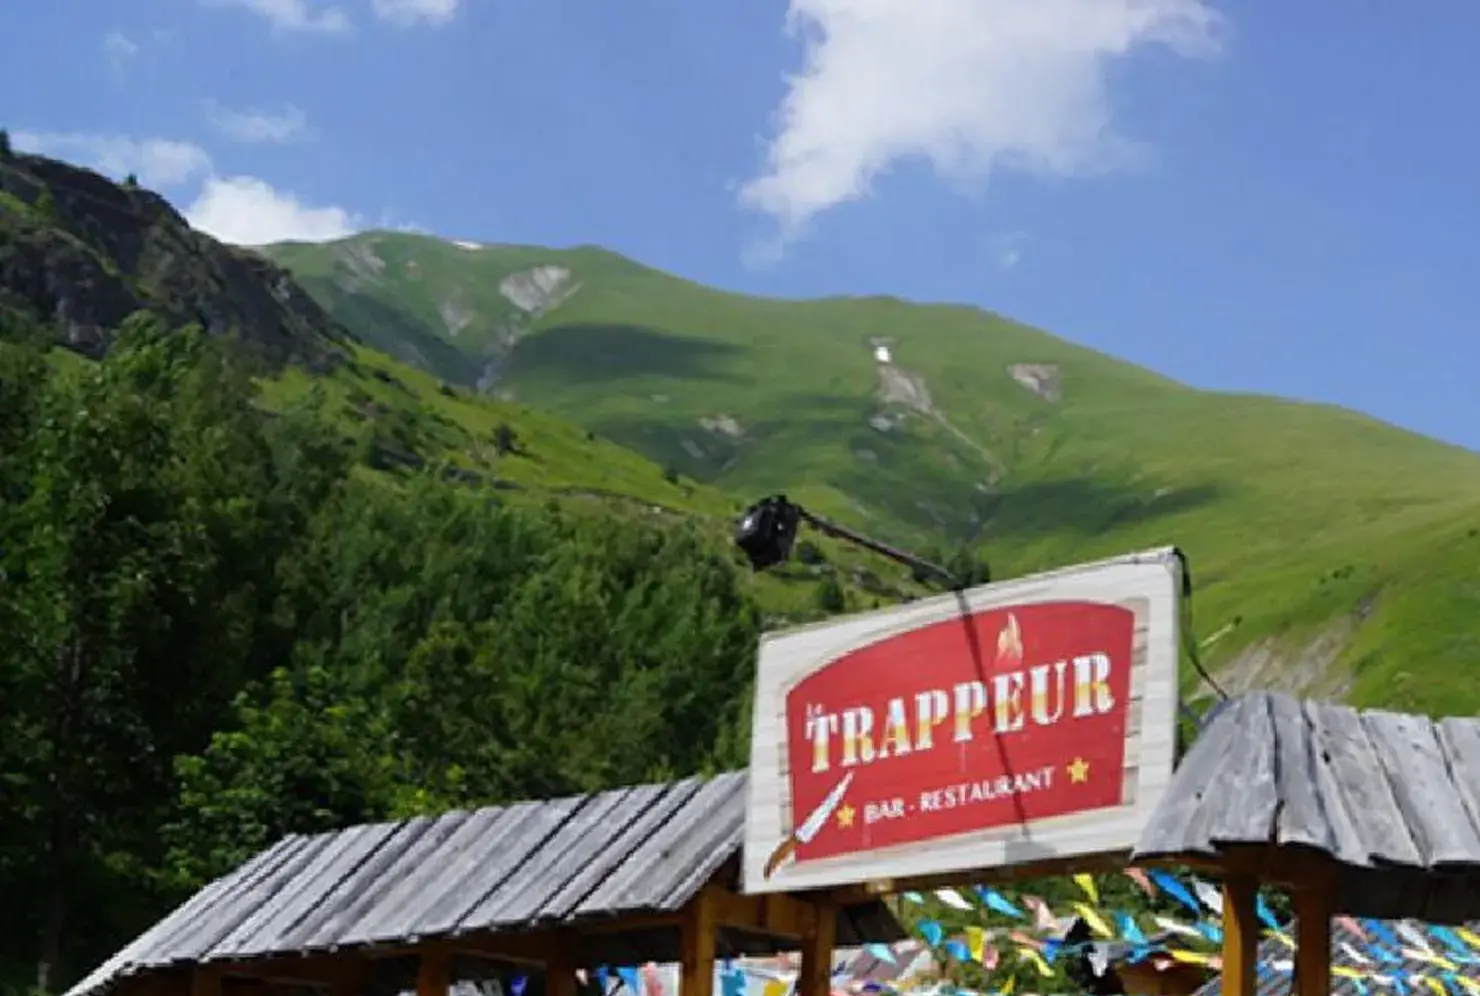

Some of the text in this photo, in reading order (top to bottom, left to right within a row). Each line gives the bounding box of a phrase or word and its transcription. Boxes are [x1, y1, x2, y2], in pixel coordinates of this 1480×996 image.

[804, 653, 1115, 774] TRAPPEUR
[863, 797, 905, 825] BAR
[919, 766, 1055, 813] RESTAURANT
